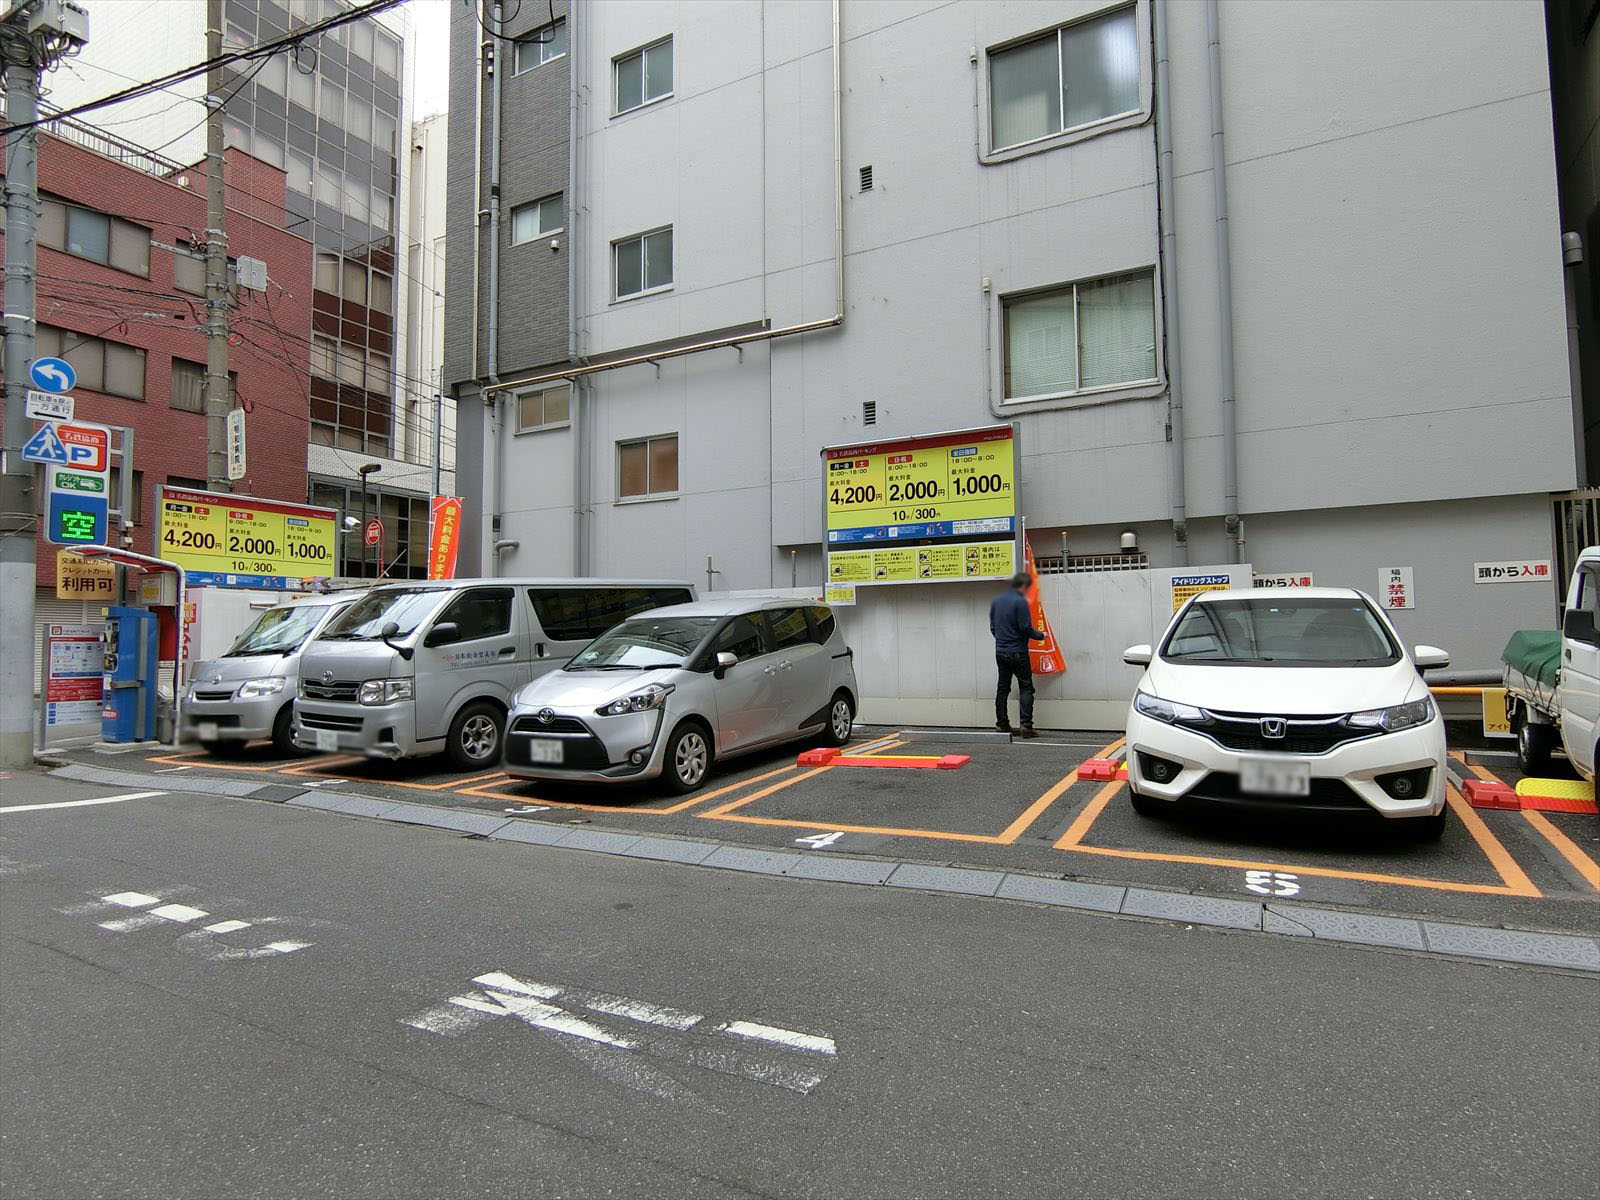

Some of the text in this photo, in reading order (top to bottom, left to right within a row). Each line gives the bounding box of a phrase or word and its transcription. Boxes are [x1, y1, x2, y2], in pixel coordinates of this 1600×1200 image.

[30, 402, 70, 414] 一方通行
[71, 446, 92, 461] P
[952, 467, 976, 475] 最大料金
[61, 481, 76, 489] OK
[889, 480, 945, 501] 2,000円
[953, 474, 1010, 496] 1,000円
[830, 485, 882, 505] 4,200円
[62, 512, 95, 540] 空
[165, 520, 189, 528] 最大料金
[164, 529, 222, 549] 4,200円
[229, 528, 251, 536] 最大料金
[229, 537, 281, 555] 2,000円
[288, 542, 332, 560] 1,000円
[62, 567, 112, 575] クレジットカード
[1478, 564, 1548, 579] 頭から入庫
[62, 576, 113, 592] 利用可
[1173, 576, 1229, 586] アイドリングストップ
[1253, 577, 1311, 588] 頭から入庫
[794, 831, 845, 849] 4
[1245, 870, 1302, 896] 5
